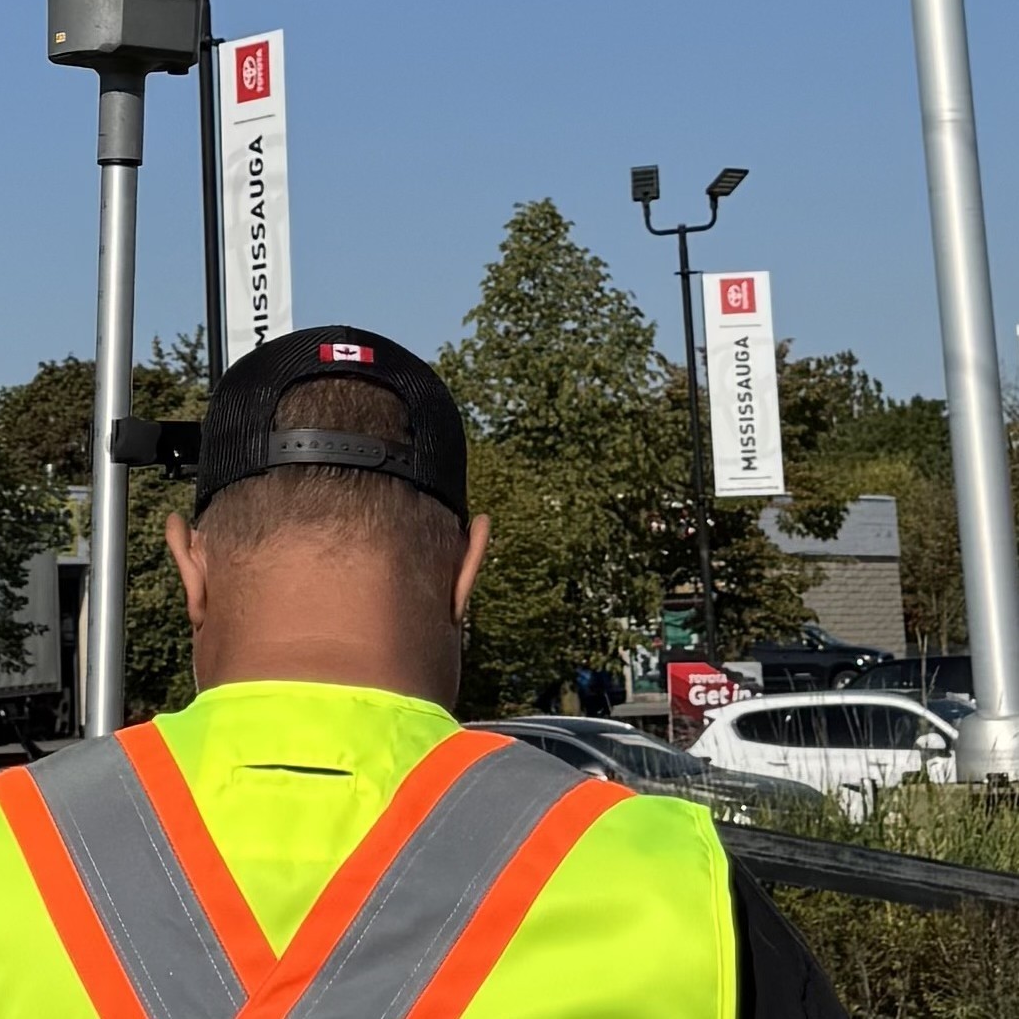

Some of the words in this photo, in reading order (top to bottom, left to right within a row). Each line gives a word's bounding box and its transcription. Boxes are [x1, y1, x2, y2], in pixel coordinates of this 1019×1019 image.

[248, 134, 269, 348] MISSISSAUGA
[734, 336, 758, 471] MISSISSAUGA
[688, 684, 730, 706] Get
